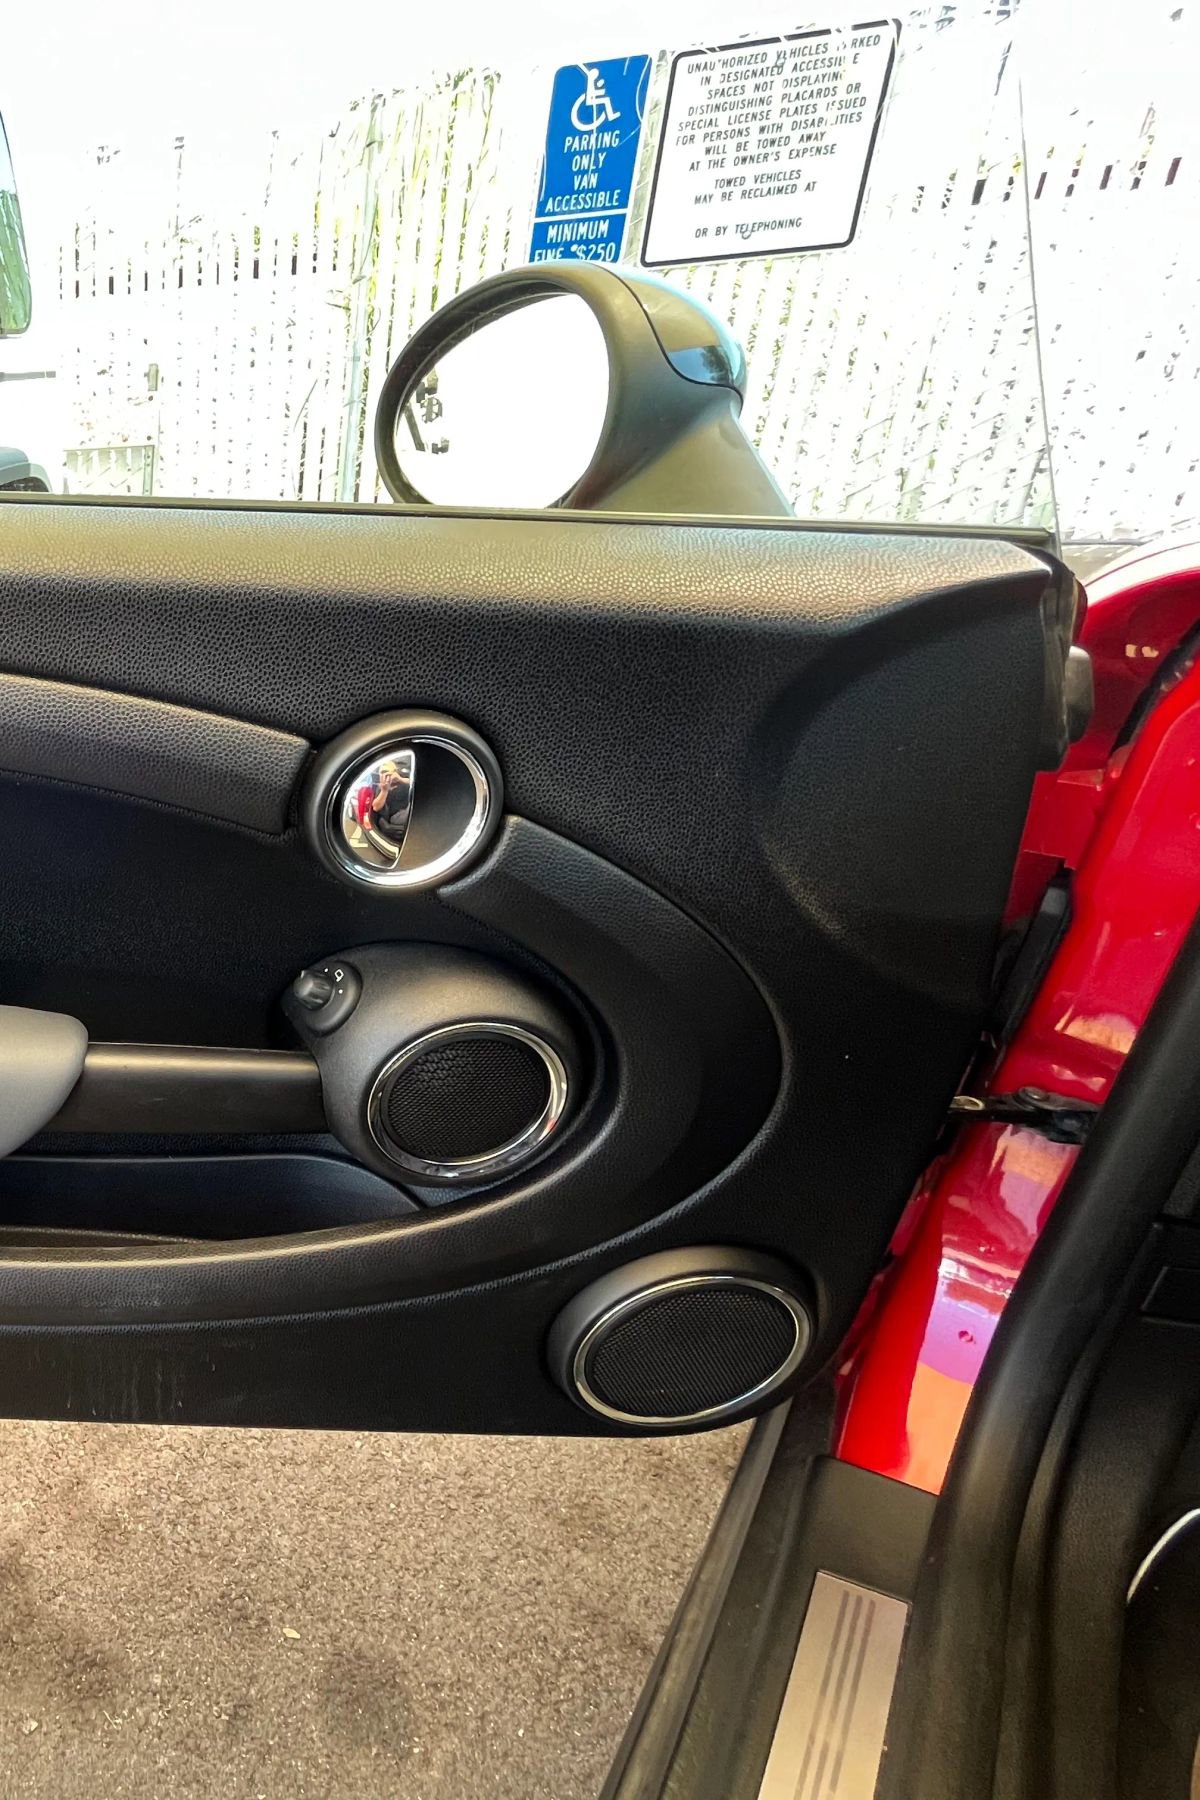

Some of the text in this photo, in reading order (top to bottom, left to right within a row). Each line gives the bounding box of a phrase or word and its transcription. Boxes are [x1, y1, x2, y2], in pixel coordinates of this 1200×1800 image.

[836, 34, 881, 51] RKED
[700, 76, 711, 86] IN
[792, 53, 860, 73] ACCESSIE
[688, 82, 861, 117] DISTINGUISHING PLACARDS OR
[707, 85, 746, 100] SPACES
[753, 80, 774, 93] NOT
[676, 112, 863, 146] FOR PERSONS WITH DISABIITIES
[678, 118, 719, 132] SPECIAL
[728, 110, 772, 125] LICENSE
[779, 104, 818, 118] PLATES
[564, 130, 620, 153] PARKING
[705, 131, 826, 156] WILL BE TOWED AWAY
[572, 152, 606, 171] ONLY
[689, 143, 837, 171] AT THE OWNER'S EXPENSE
[573, 173, 598, 191] VAN
[714, 170, 802, 189] TOWED VEHICLES
[545, 189, 621, 213] ACCESSIBLE
[694, 181, 817, 205] MAY BE RECLAIMED AT
[547, 219, 609, 244] MINIMUM
[695, 218, 802, 238] OR BY TELEPHONING
[576, 242, 616, 262] $250
